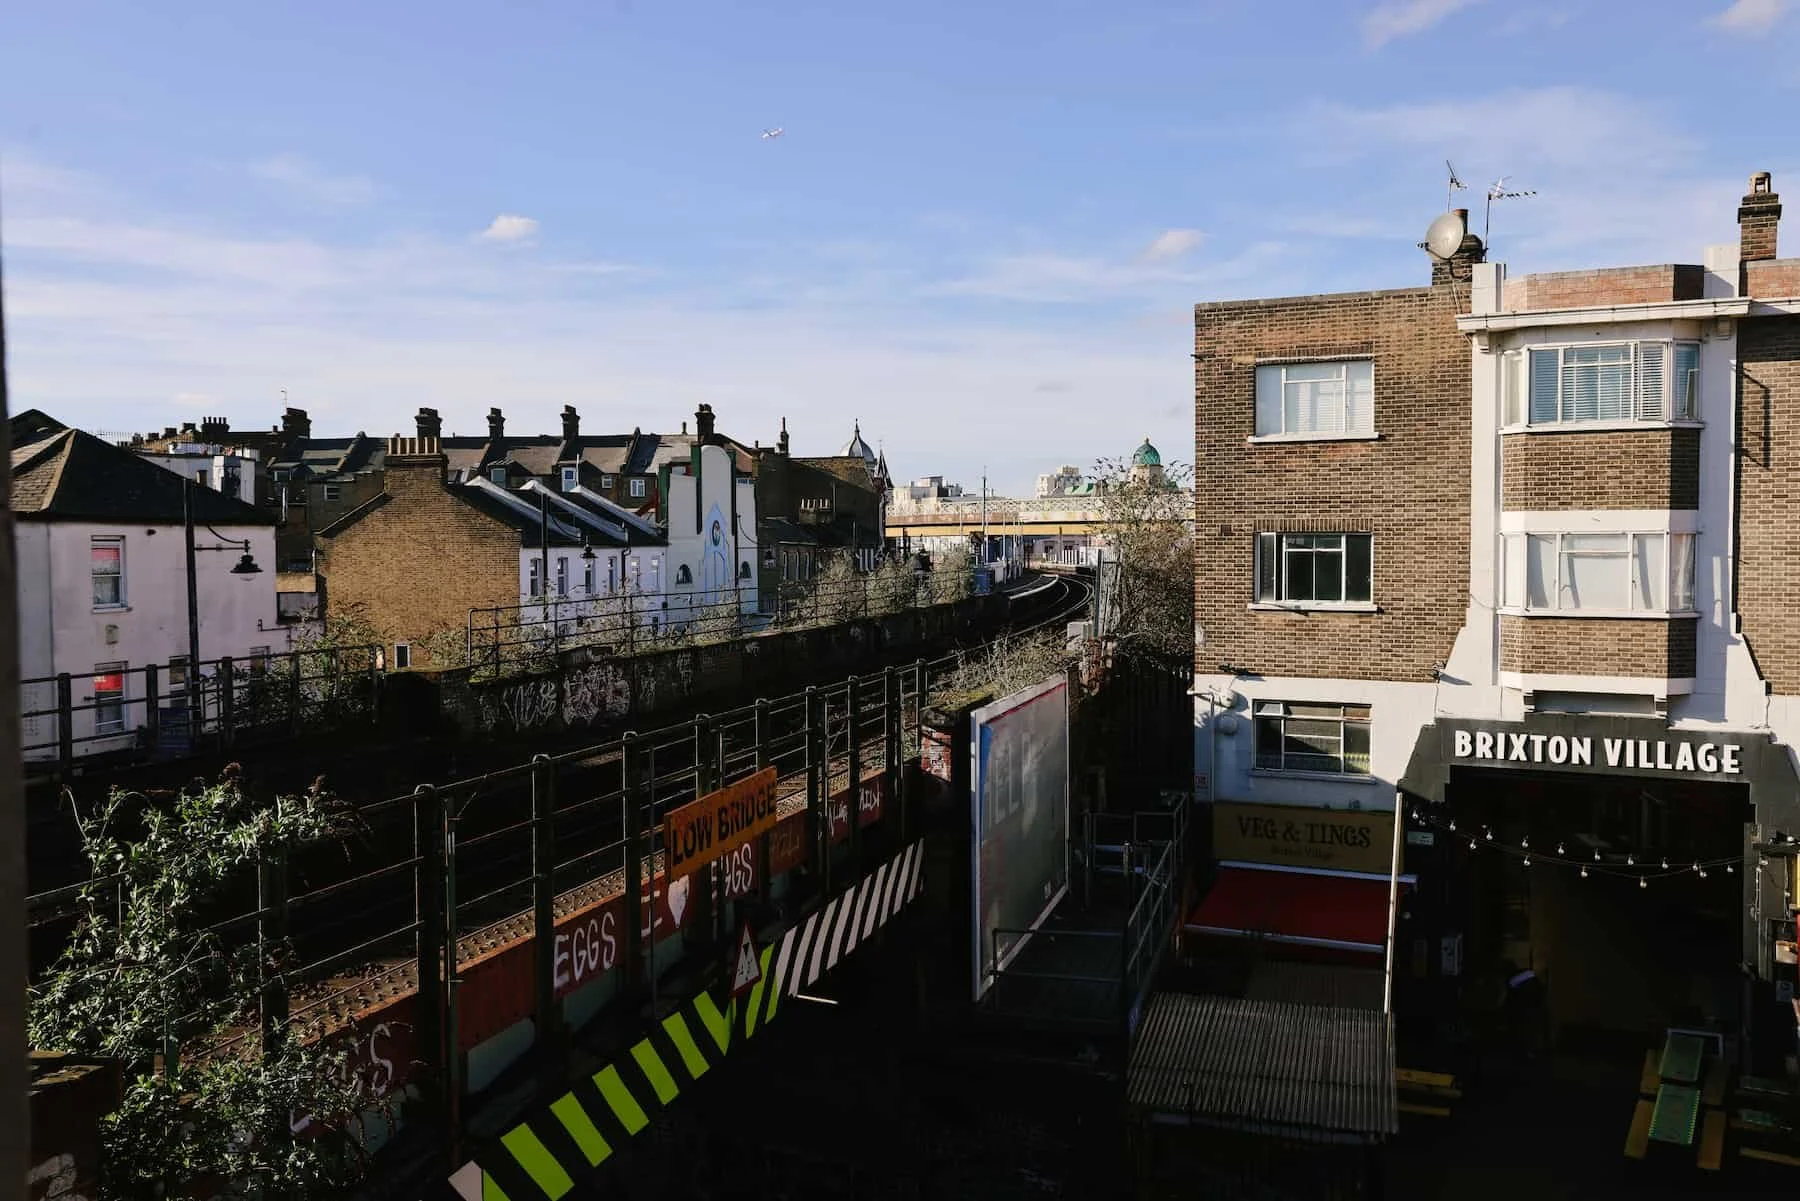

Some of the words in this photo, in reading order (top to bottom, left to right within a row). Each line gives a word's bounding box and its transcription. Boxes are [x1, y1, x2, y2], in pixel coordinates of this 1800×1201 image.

[1454, 730, 1593, 766] BRIXTON
[1604, 737, 1743, 774] VILLAGE
[673, 815, 712, 867] LOW
[718, 784, 777, 842] BRIDGE
[1238, 814, 1277, 840] VEG
[1282, 821, 1300, 843] &
[1304, 823, 1371, 849] TINGS
[553, 912, 616, 990] EGGS
